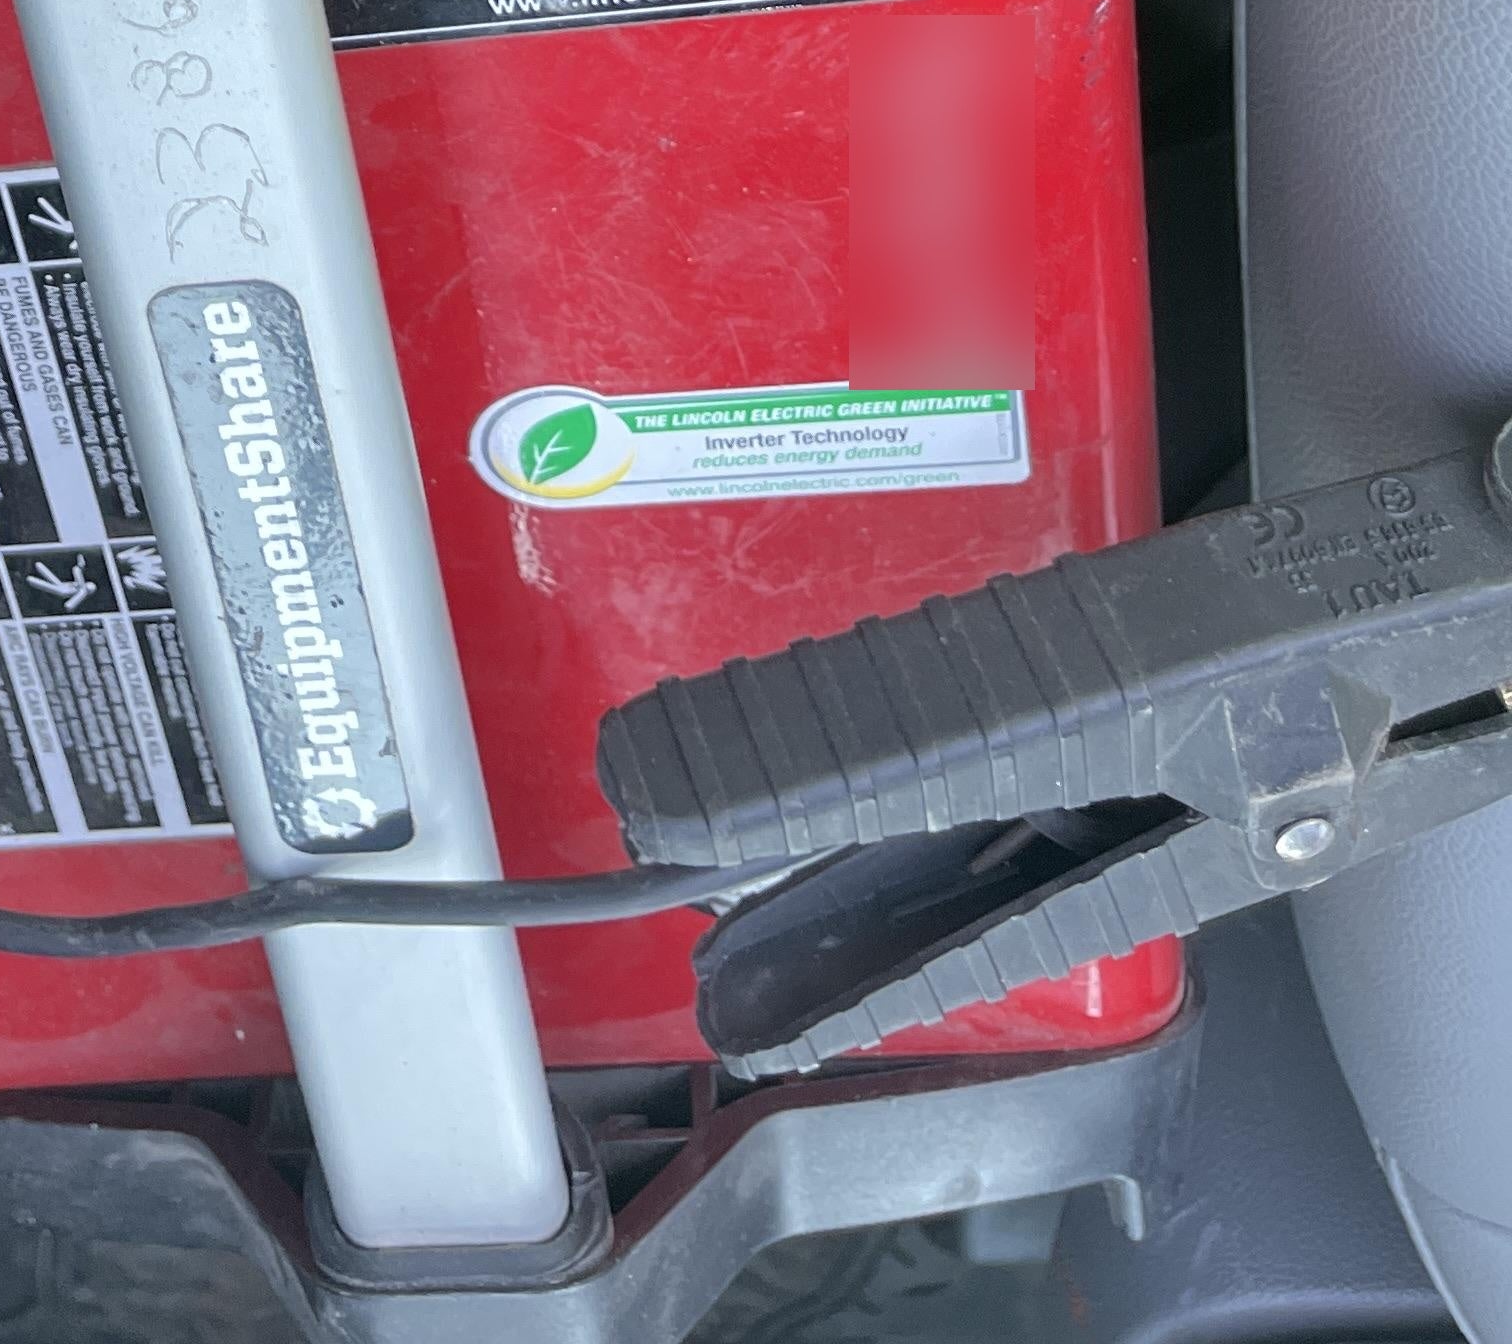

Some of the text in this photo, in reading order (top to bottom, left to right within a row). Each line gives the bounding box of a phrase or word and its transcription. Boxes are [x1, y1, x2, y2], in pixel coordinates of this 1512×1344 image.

[11, 275, 73, 445] FUMES AND GASES CAN
[635, 414, 668, 430] THE
[671, 409, 746, 428] LINCOLN
[750, 404, 833, 424] ELECTRIC
[837, 399, 896, 419] GREEN
[705, 425, 909, 452] Inverter Technology
[692, 440, 922, 470] reduces energy demand
[203, 297, 356, 779] EquipmentShare
